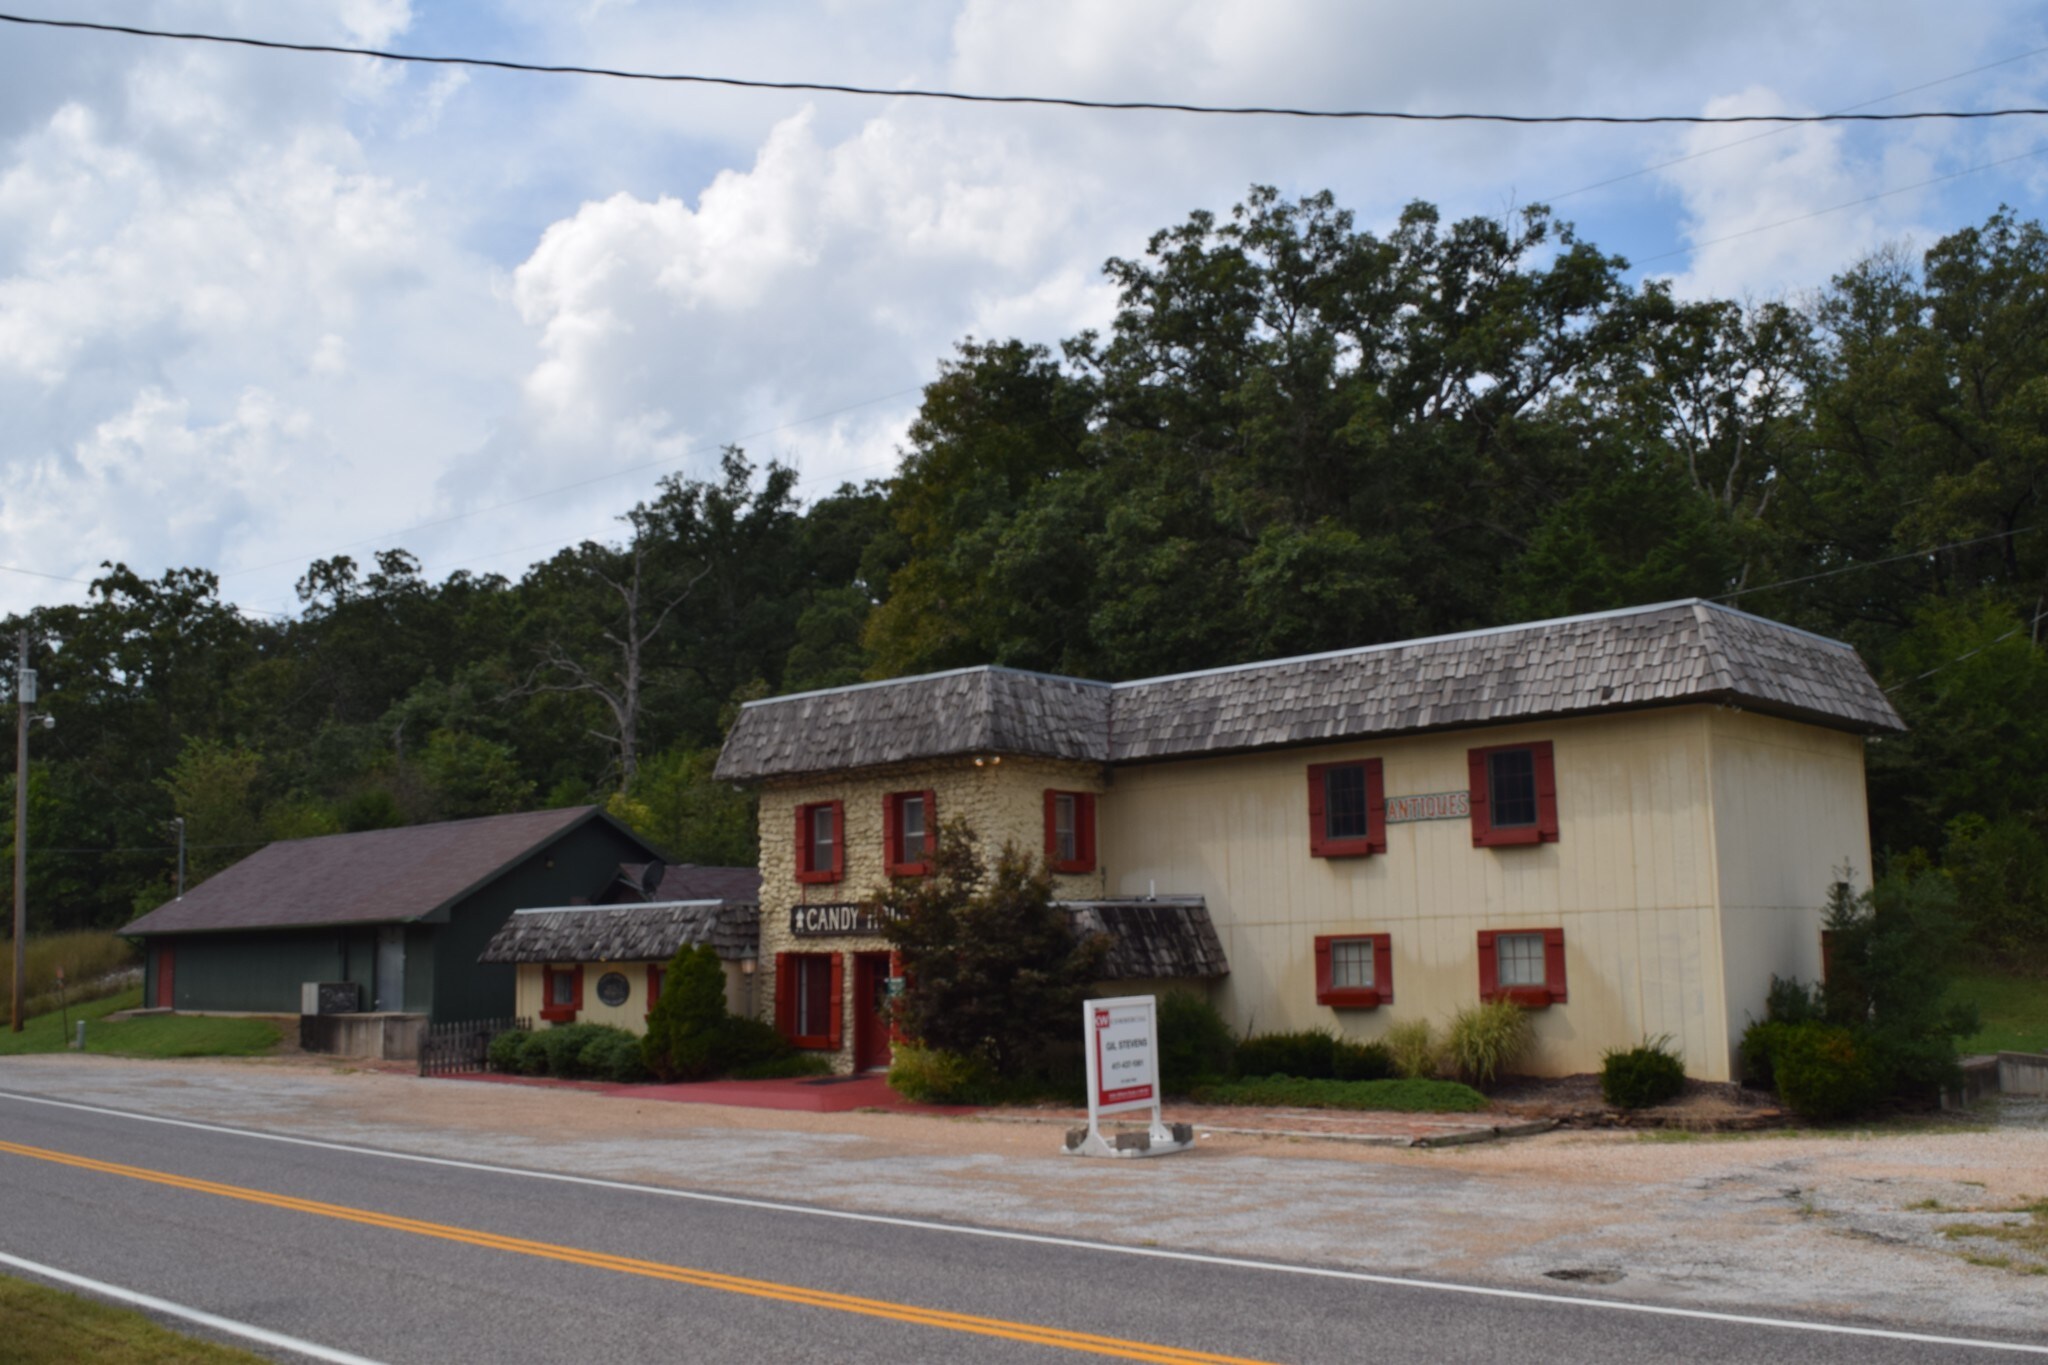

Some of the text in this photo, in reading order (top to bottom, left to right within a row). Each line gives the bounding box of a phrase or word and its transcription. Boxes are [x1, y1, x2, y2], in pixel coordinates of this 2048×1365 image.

[1388, 793, 1469, 819] ANTIQUES
[806, 906, 859, 931] CANDY
[1119, 1037, 1148, 1050] STEVENS
